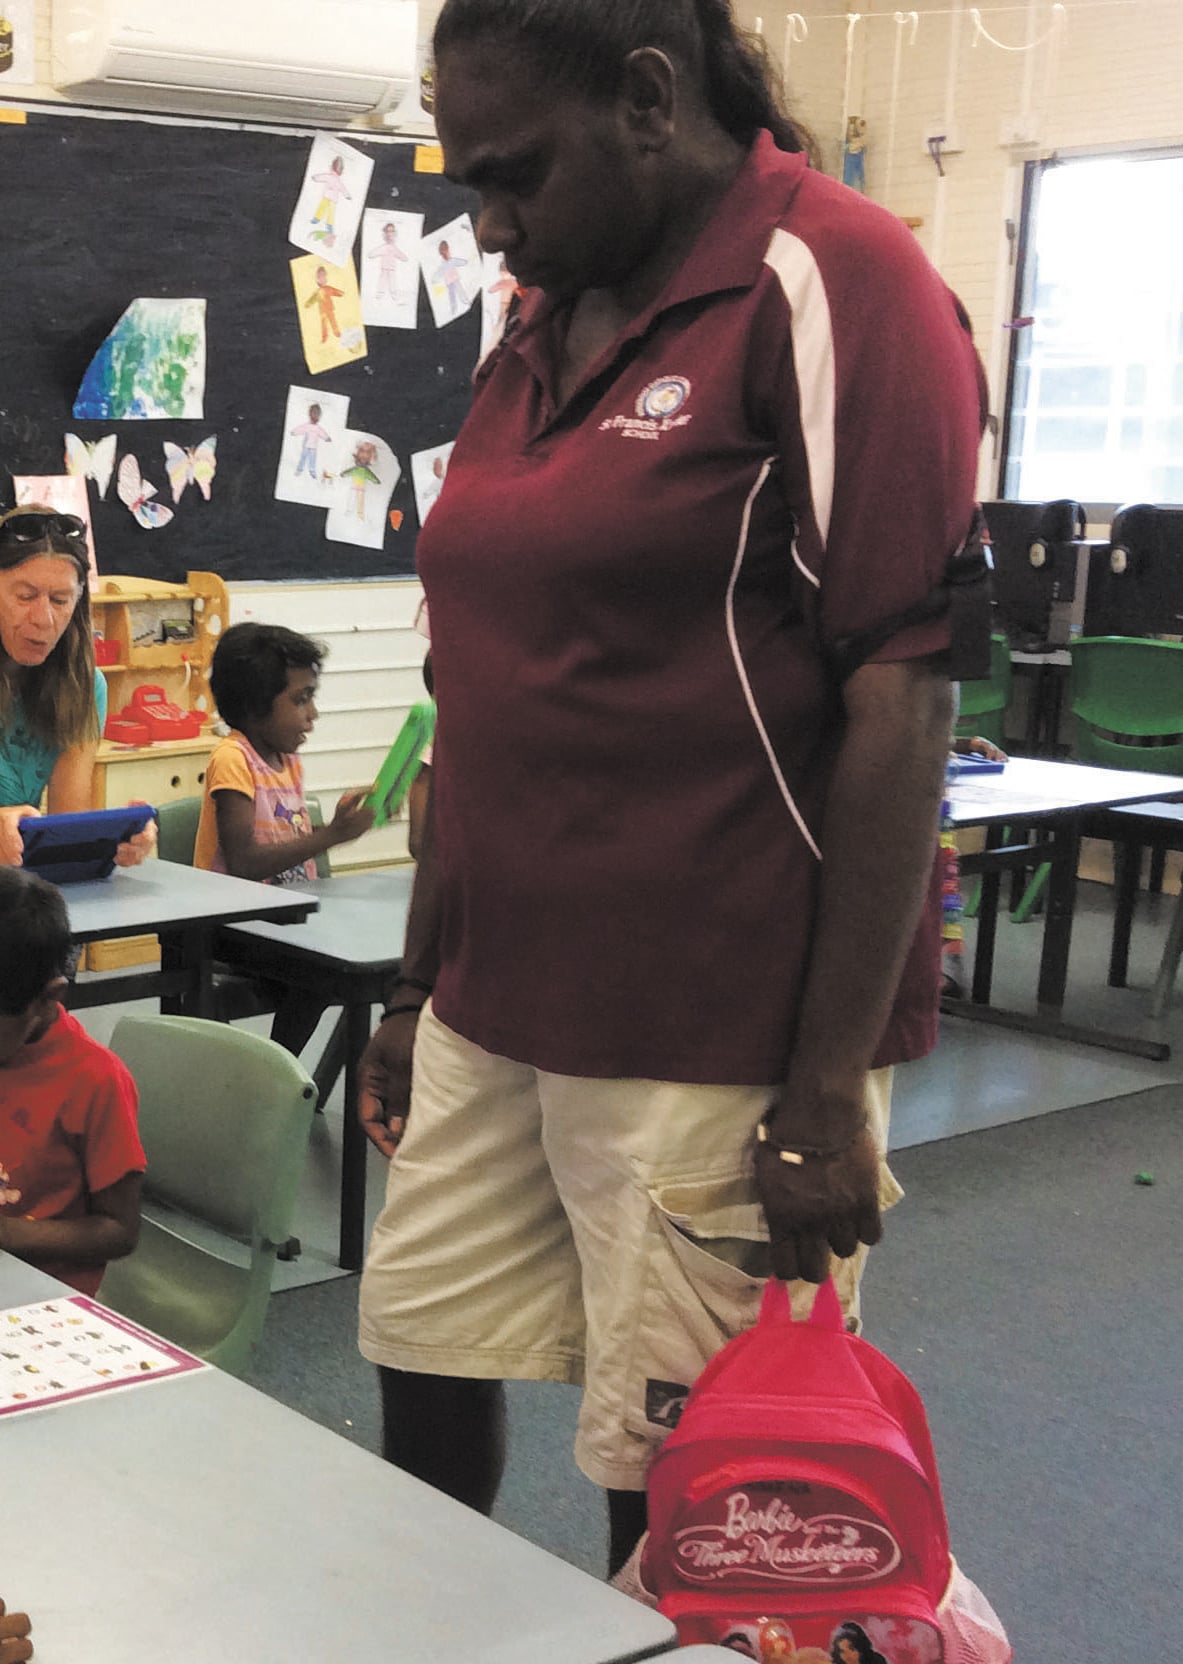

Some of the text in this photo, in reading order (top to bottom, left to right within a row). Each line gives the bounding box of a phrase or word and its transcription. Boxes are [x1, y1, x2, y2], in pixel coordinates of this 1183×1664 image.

[725, 1492, 804, 1539] Barbie
[678, 1533, 879, 1567] Three Musketeers
